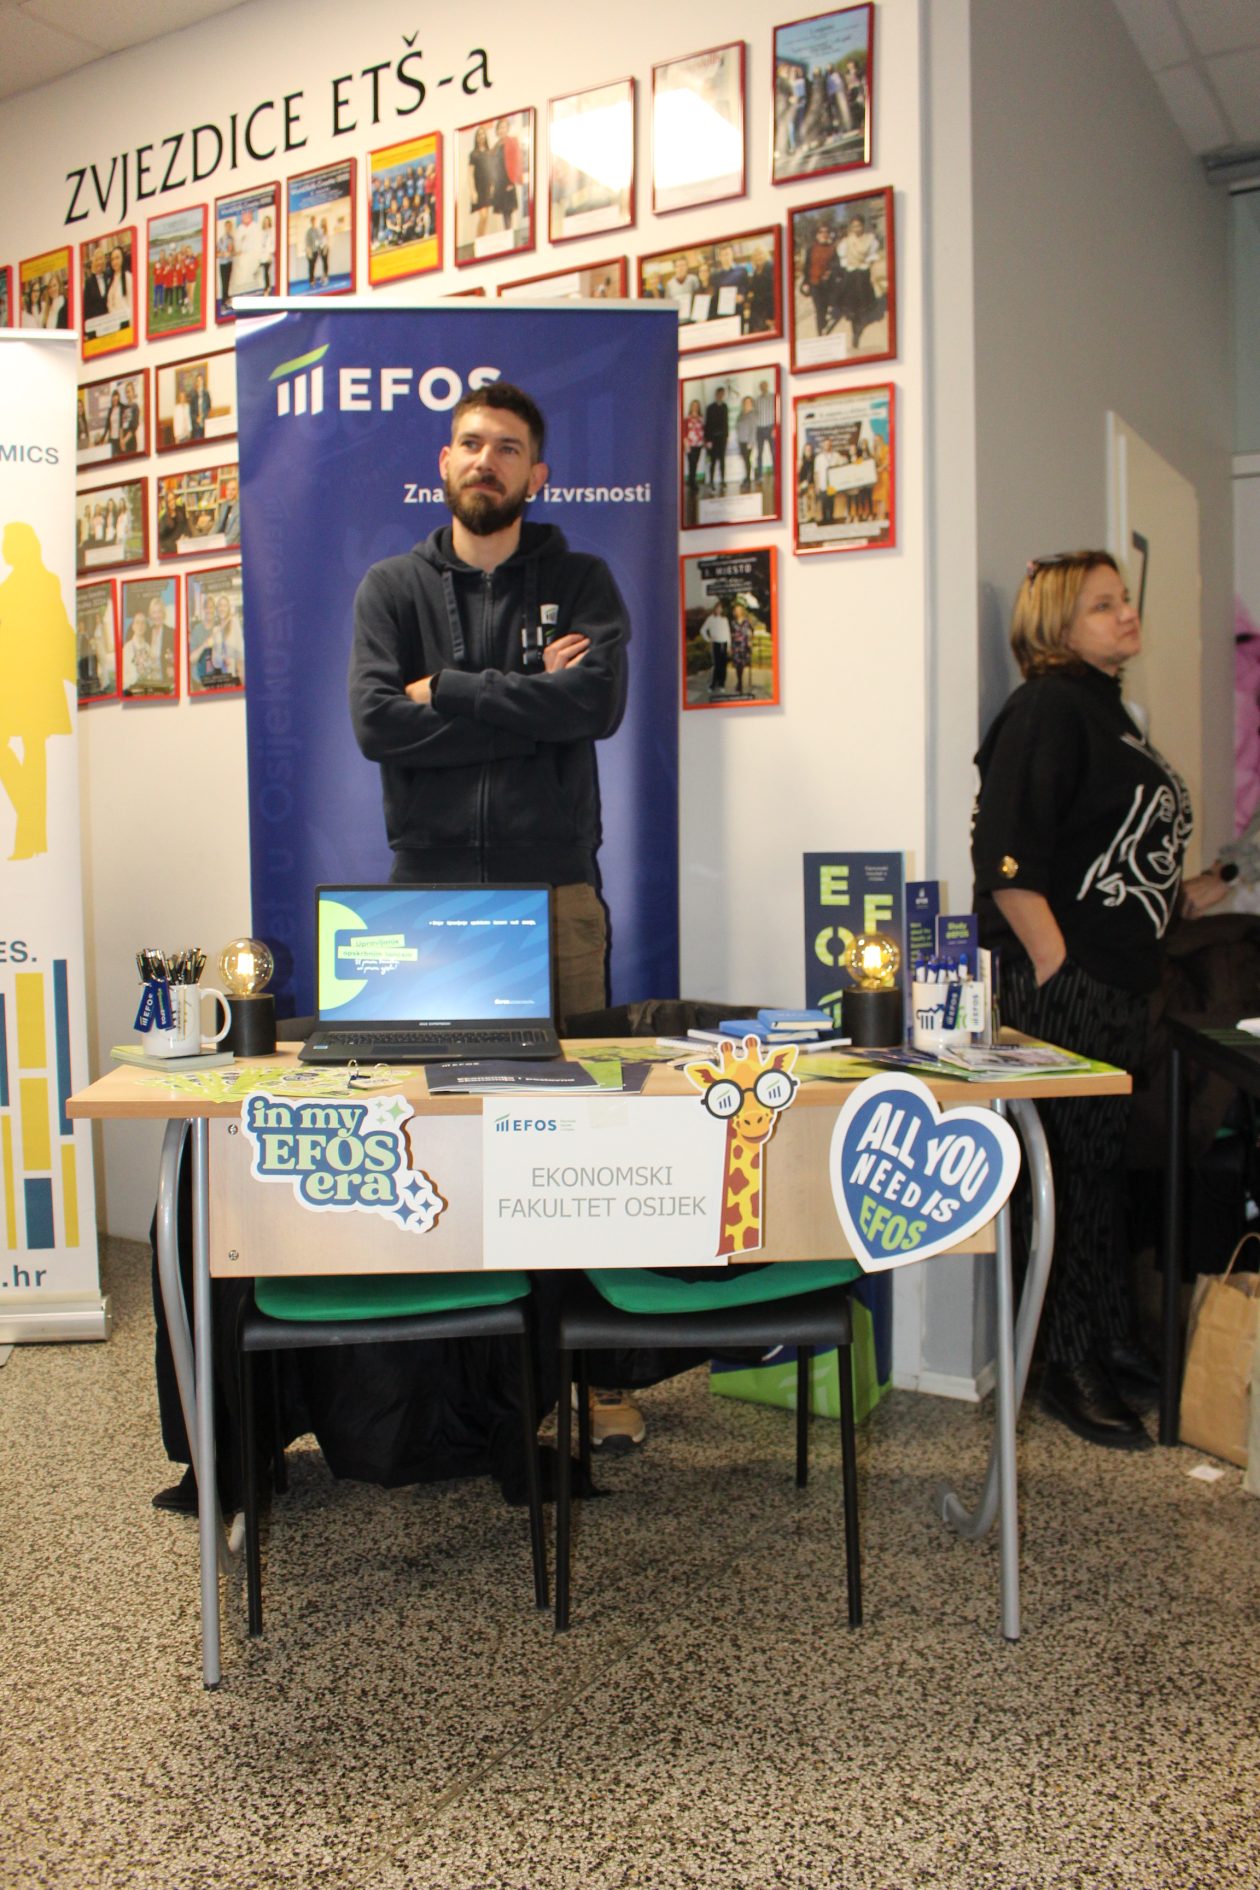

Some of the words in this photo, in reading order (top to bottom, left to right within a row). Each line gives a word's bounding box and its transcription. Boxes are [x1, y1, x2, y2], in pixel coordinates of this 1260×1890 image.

[65, 91, 307, 225] ZVJEZDICE
[332, 31, 493, 137] ETŠ-a
[544, 483, 651, 503] izvrsnosti
[253, 1100, 293, 1129] in
[300, 1107, 363, 1138] my
[513, 1119, 557, 1132] EFOS
[262, 1134, 396, 1171] EFOS
[856, 1102, 922, 1170] ALL
[923, 1134, 990, 1203] YOU
[305, 1172, 393, 1200] era
[531, 1166, 673, 1187] EKONOMSKI
[849, 1153, 922, 1208] NEED
[920, 1190, 961, 1223] IS
[498, 1197, 616, 1218] FAKULTET
[625, 1196, 707, 1217] OSIJEK
[859, 1195, 927, 1251] EFOS
[2, 1265, 47, 1288] .hr
